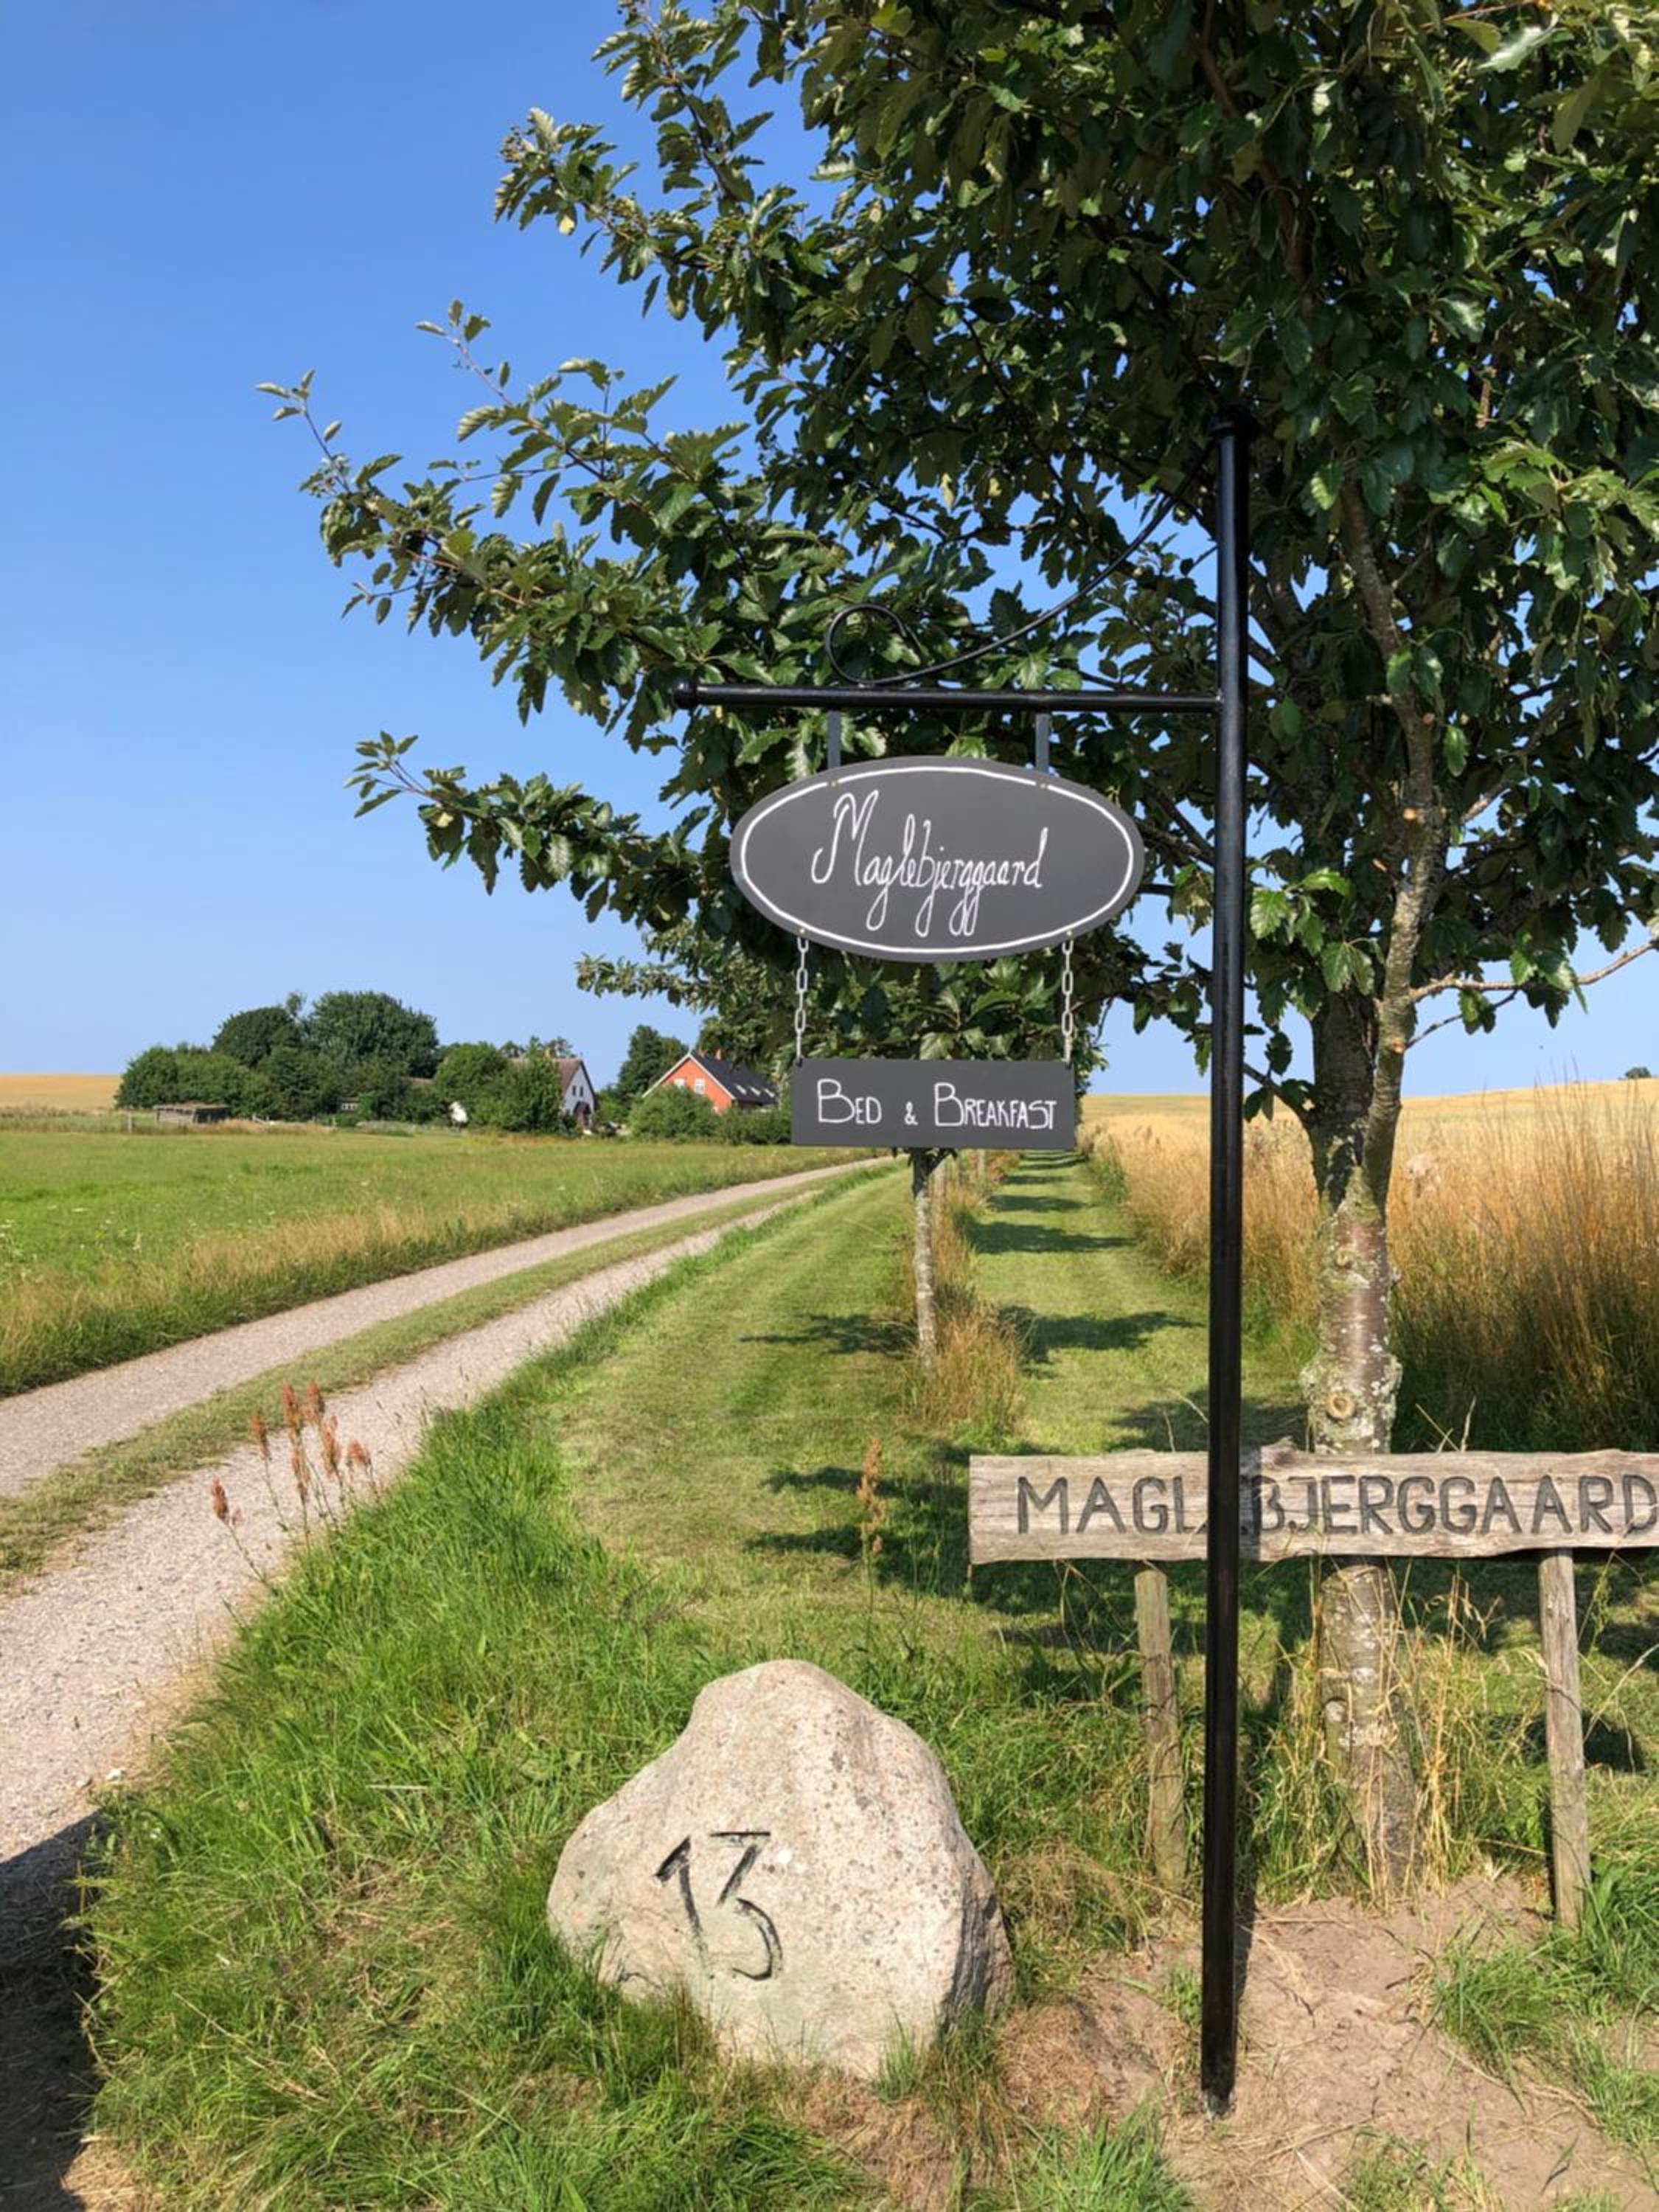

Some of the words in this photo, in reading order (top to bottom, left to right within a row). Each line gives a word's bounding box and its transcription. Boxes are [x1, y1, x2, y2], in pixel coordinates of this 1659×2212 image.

[811, 789, 1048, 937] Maglebjerggaard
[816, 1078, 883, 1125] BED
[903, 1101, 919, 1127] &
[933, 1082, 1057, 1130] BREAKFAST
[1015, 1474, 1658, 1537] MAGLBJERGGAARD
[653, 1830, 784, 1982] 13
